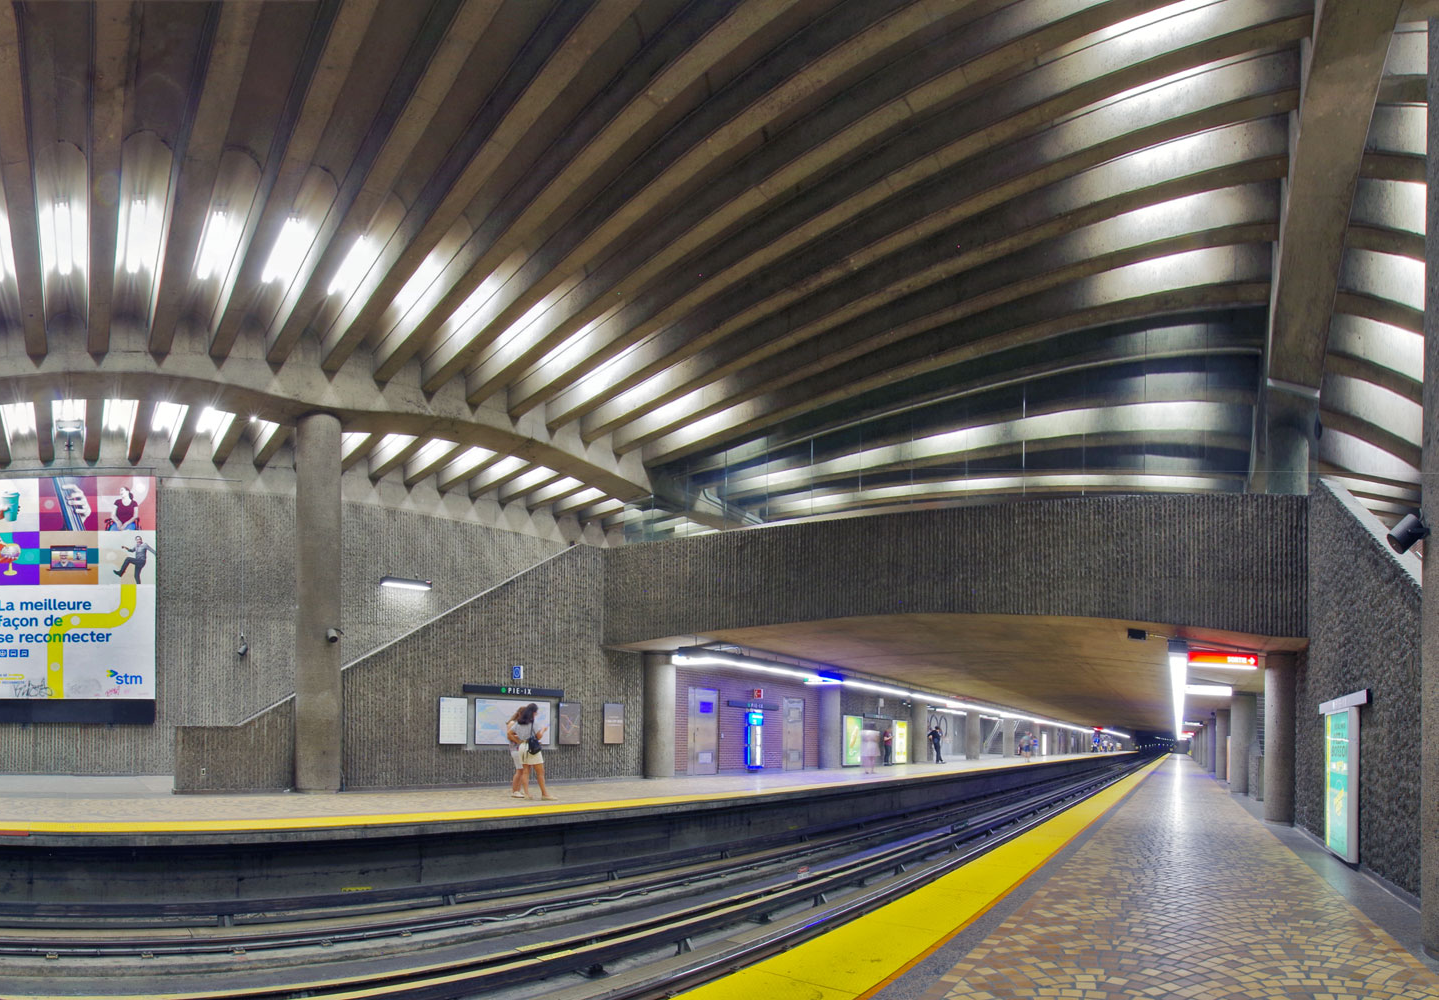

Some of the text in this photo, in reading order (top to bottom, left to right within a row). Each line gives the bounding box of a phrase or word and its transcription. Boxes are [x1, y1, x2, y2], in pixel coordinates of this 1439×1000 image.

[20, 598, 92, 611] meilleure
[44, 614, 63, 627] de
[19, 630, 112, 643] reconnecter
[115, 673, 143, 685] stm
[507, 687, 532, 695] PIE-IX
